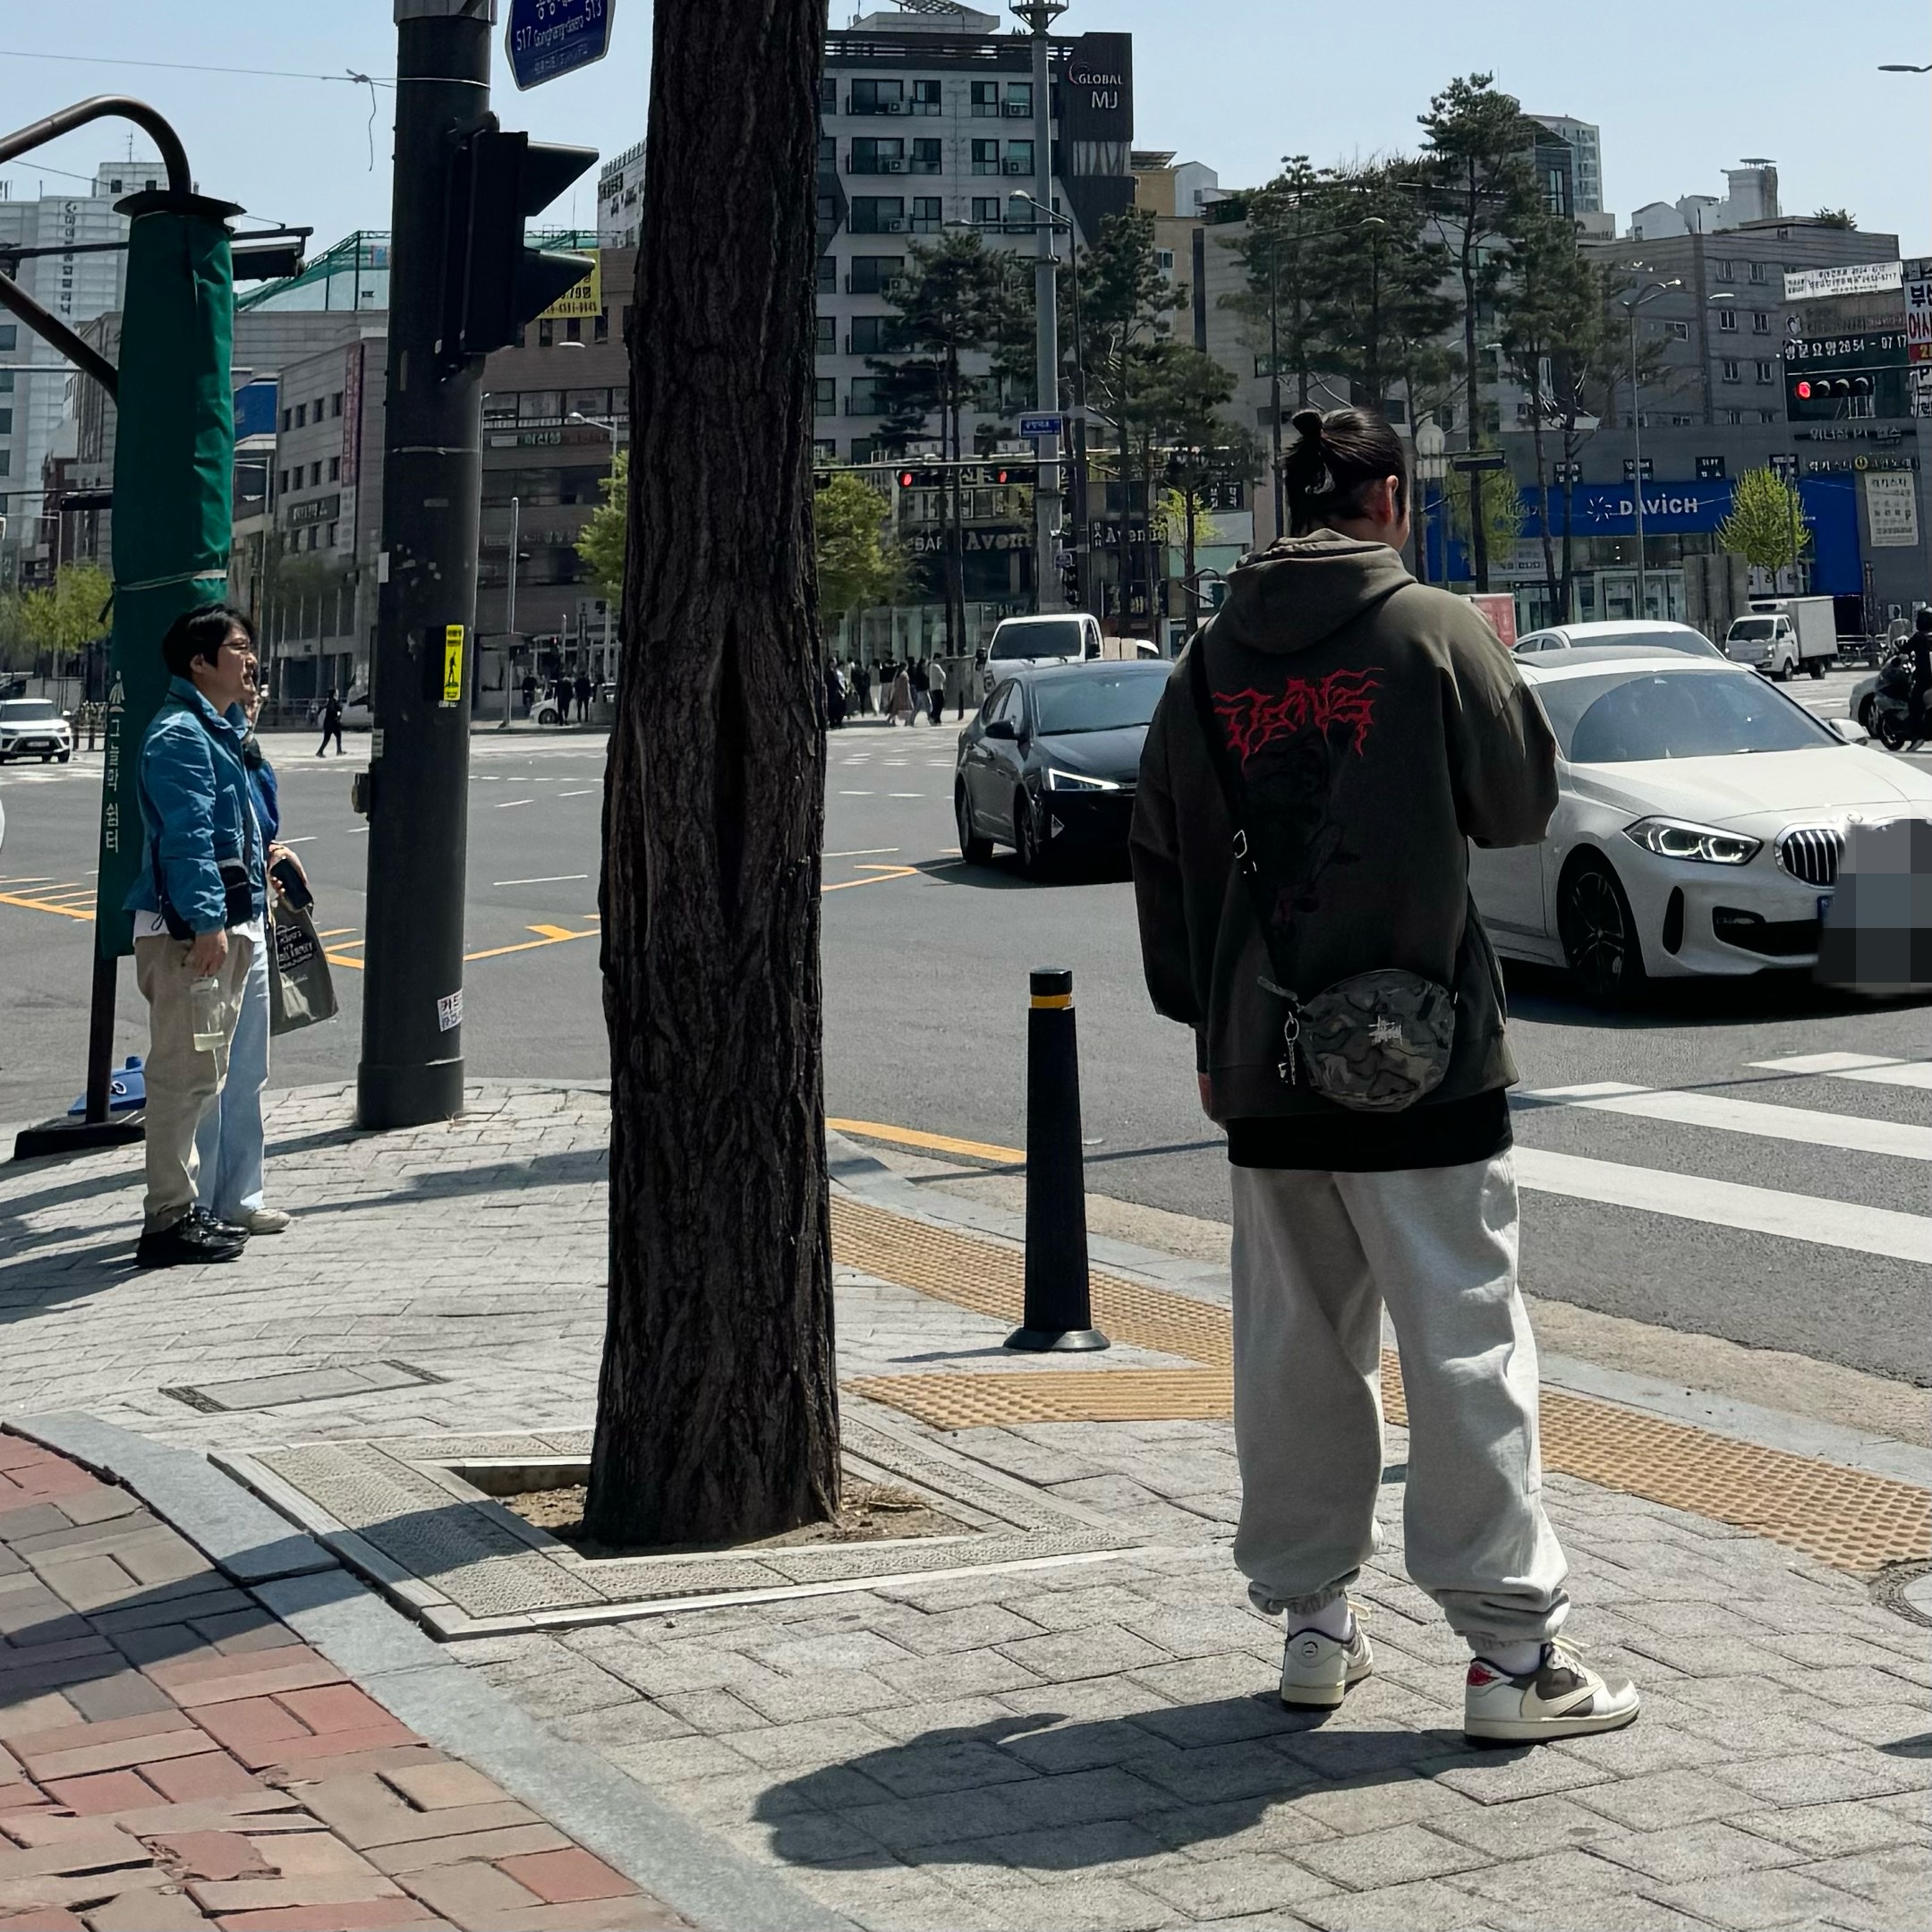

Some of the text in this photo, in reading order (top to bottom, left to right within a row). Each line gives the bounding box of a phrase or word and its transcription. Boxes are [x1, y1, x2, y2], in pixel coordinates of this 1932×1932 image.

[516, 25, 532, 51] 517
[585, 0, 602, 21] 513
[1078, 73, 1123, 85] GLOBAL
[1091, 90, 1119, 109] MJ
